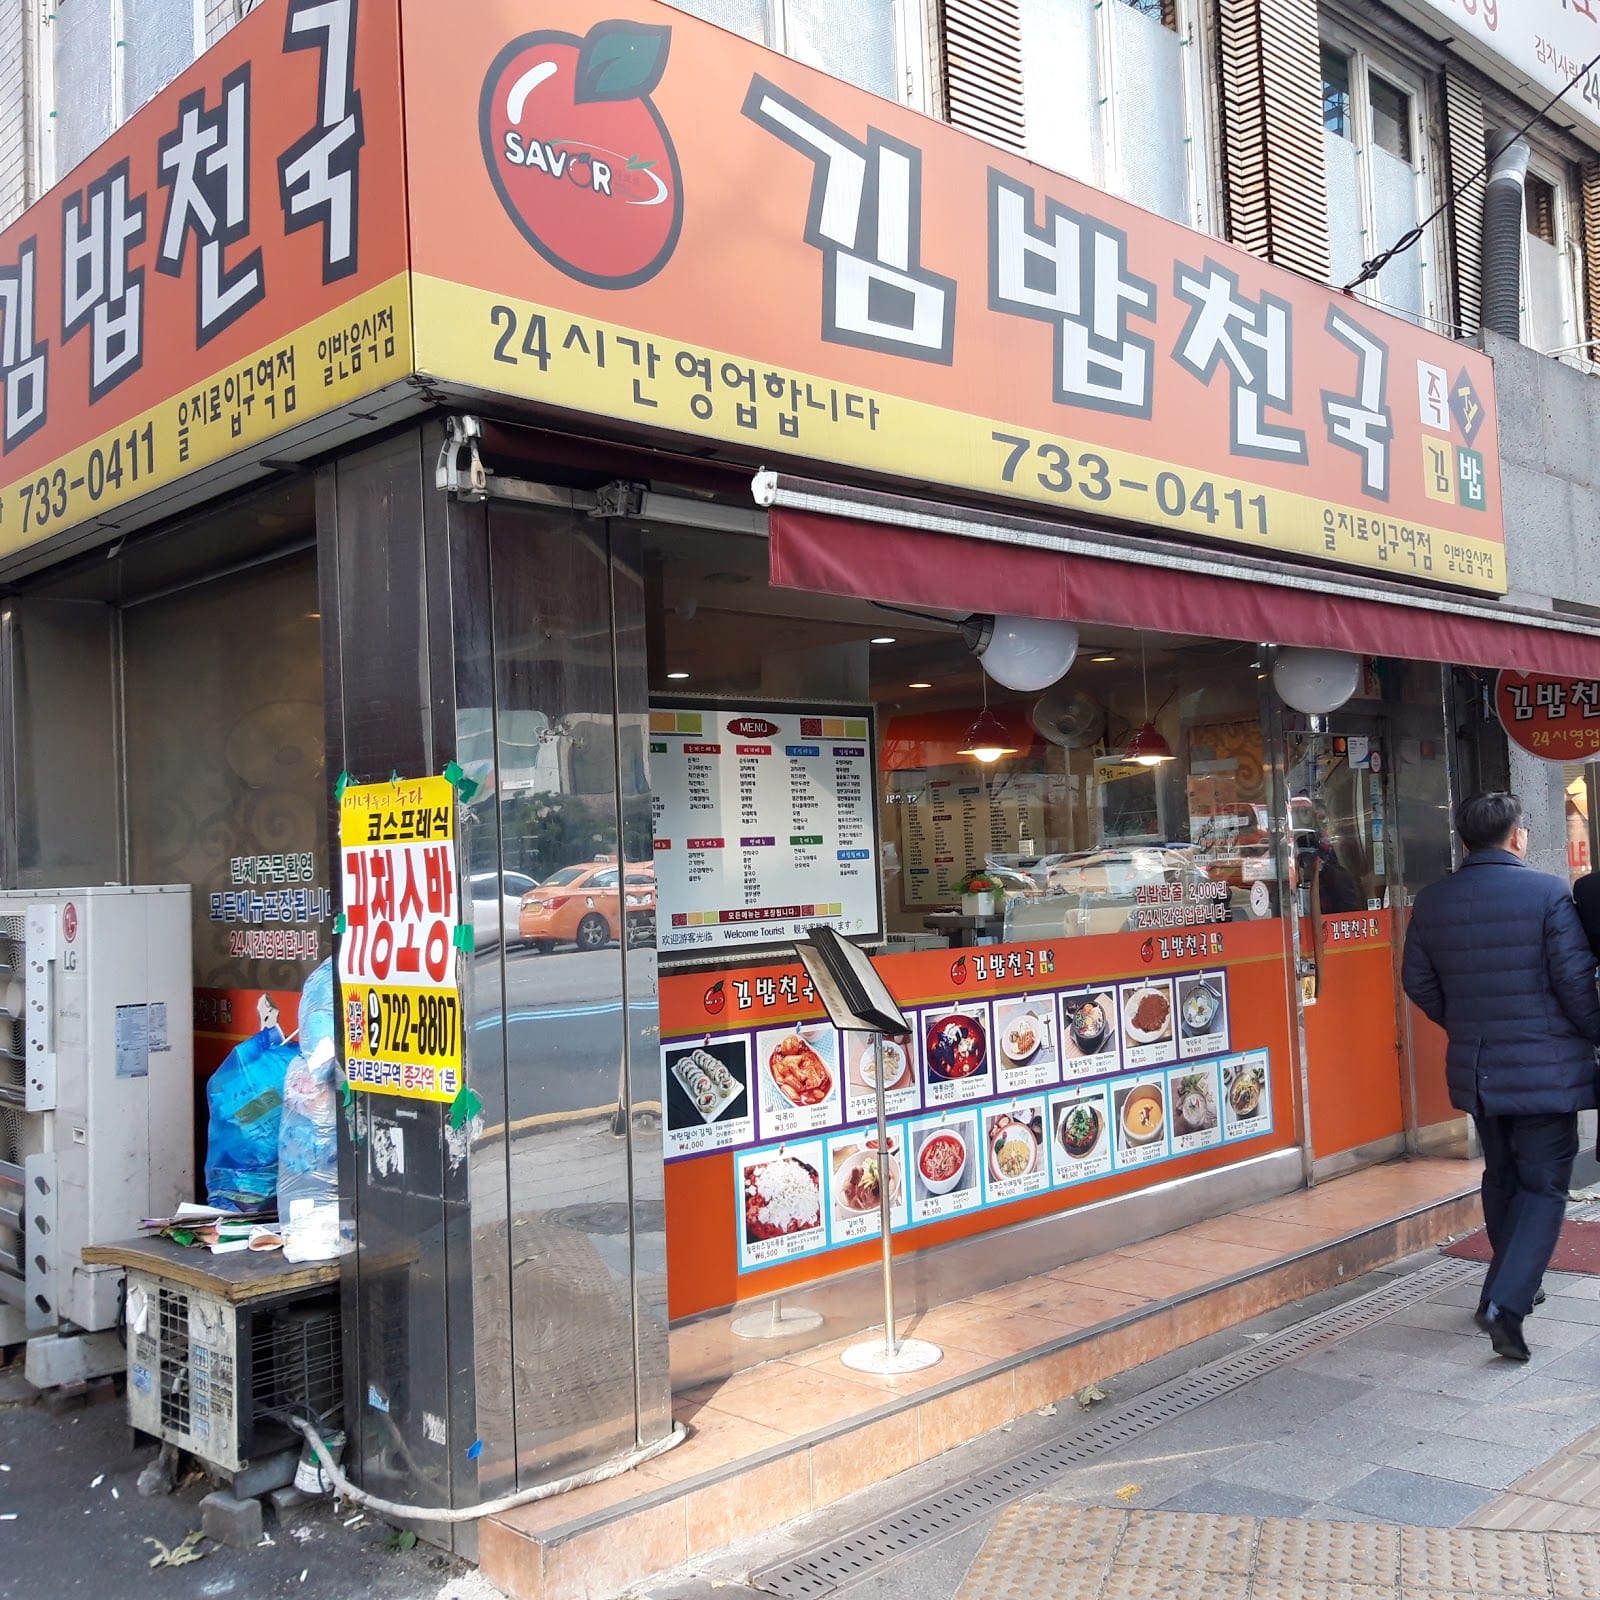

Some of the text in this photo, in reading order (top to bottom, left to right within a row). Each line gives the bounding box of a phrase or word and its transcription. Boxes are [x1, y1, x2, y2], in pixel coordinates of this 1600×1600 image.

[0, 0, 362, 444] 김밥천국
[747, 80, 1392, 500] 김밥천국
[19, 421, 155, 533] 733-0411
[177, 345, 297, 463] 을지로입구역점
[991, 431, 1268, 535] 733-0411
[1322, 508, 1432, 571] 을지로입구역점
[740, 722, 768, 733] MENU
[367, 806, 449, 841] 코스프레식
[230, 851, 314, 885] 단체주문환영
[1135, 880, 1229, 905] 김밥한줄 2,000원
[346, 845, 453, 983] 귀청소방
[1137, 902, 1228, 928] 24시간영업합니다
[1330, 918, 1368, 941] 김밥천국
[229, 930, 319, 961] 24시간영업합니다
[661, 931, 713, 946] 欢迎游客光临
[724, 925, 785, 940] Welcome Tourist
[1157, 931, 1208, 960] 김밥천국
[64, 950, 77, 971] LG
[972, 949, 1035, 981] 김밥천국
[382, 993, 456, 1057] 722-8807
[348, 1058, 401, 1087] 을지로입구역
[404, 1066, 435, 1091] 종각역
